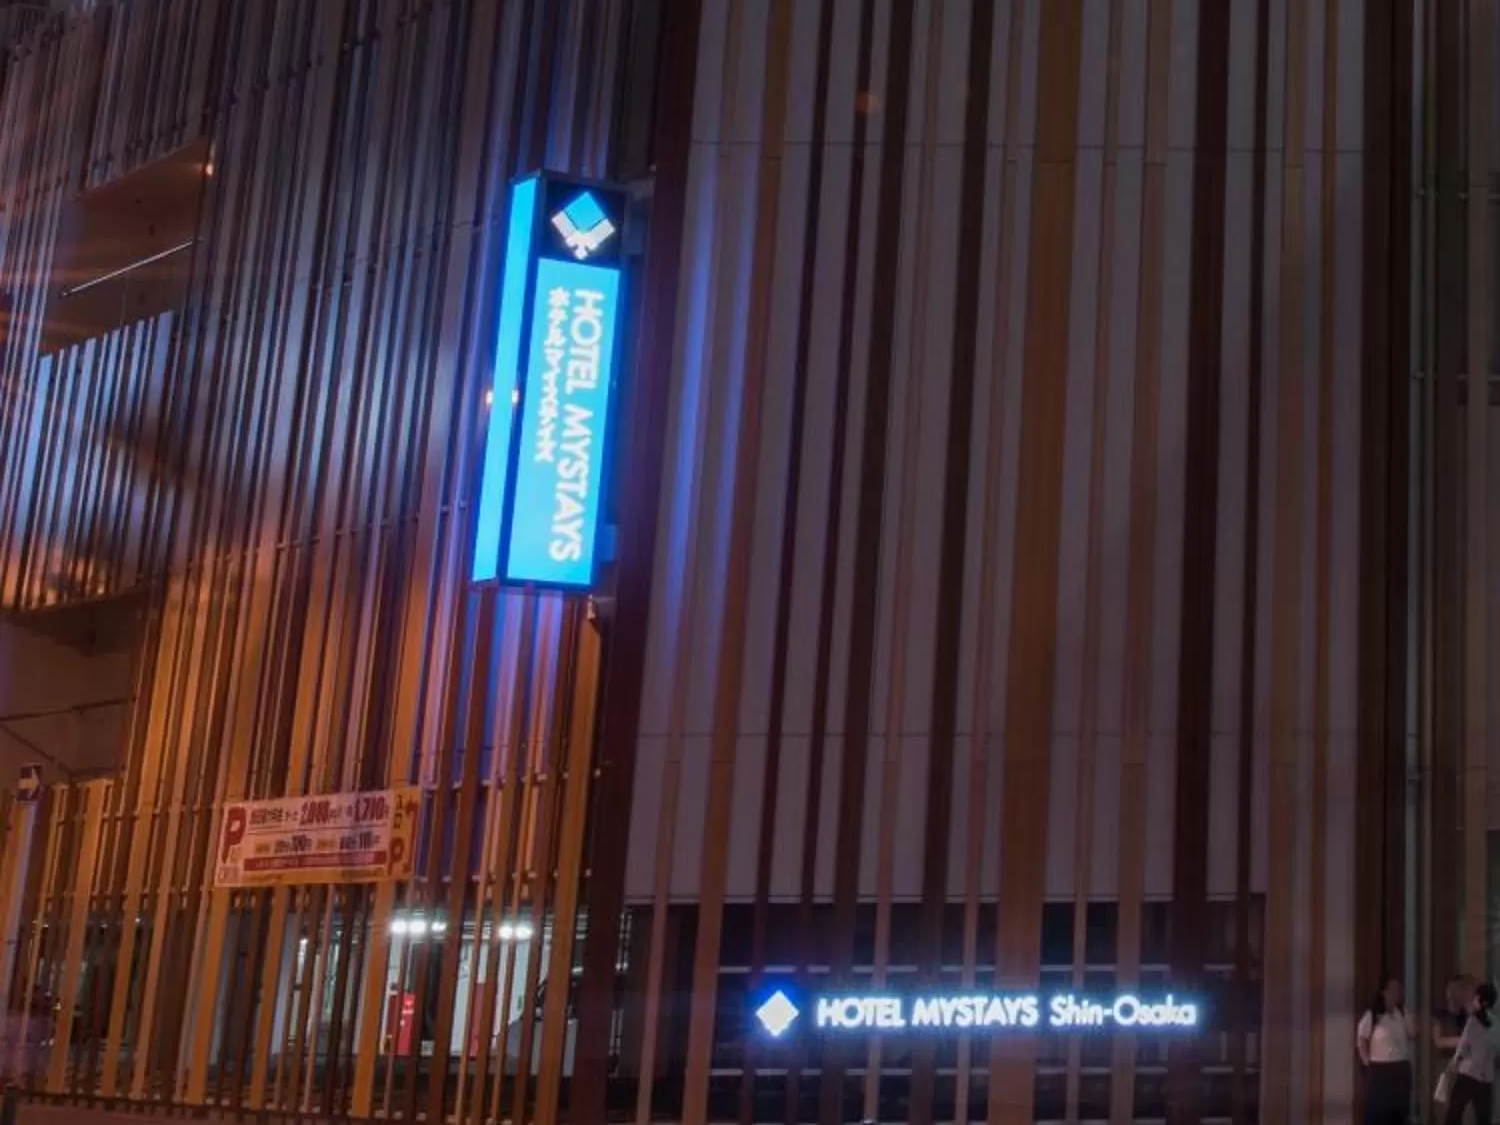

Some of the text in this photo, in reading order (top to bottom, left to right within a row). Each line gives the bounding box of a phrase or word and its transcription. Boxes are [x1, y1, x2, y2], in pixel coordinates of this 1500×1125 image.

[547, 288, 605, 563] HOTEL MYSTAYS
[816, 994, 1198, 1029] HOTEL MYSTAYS Shin-Osaka
